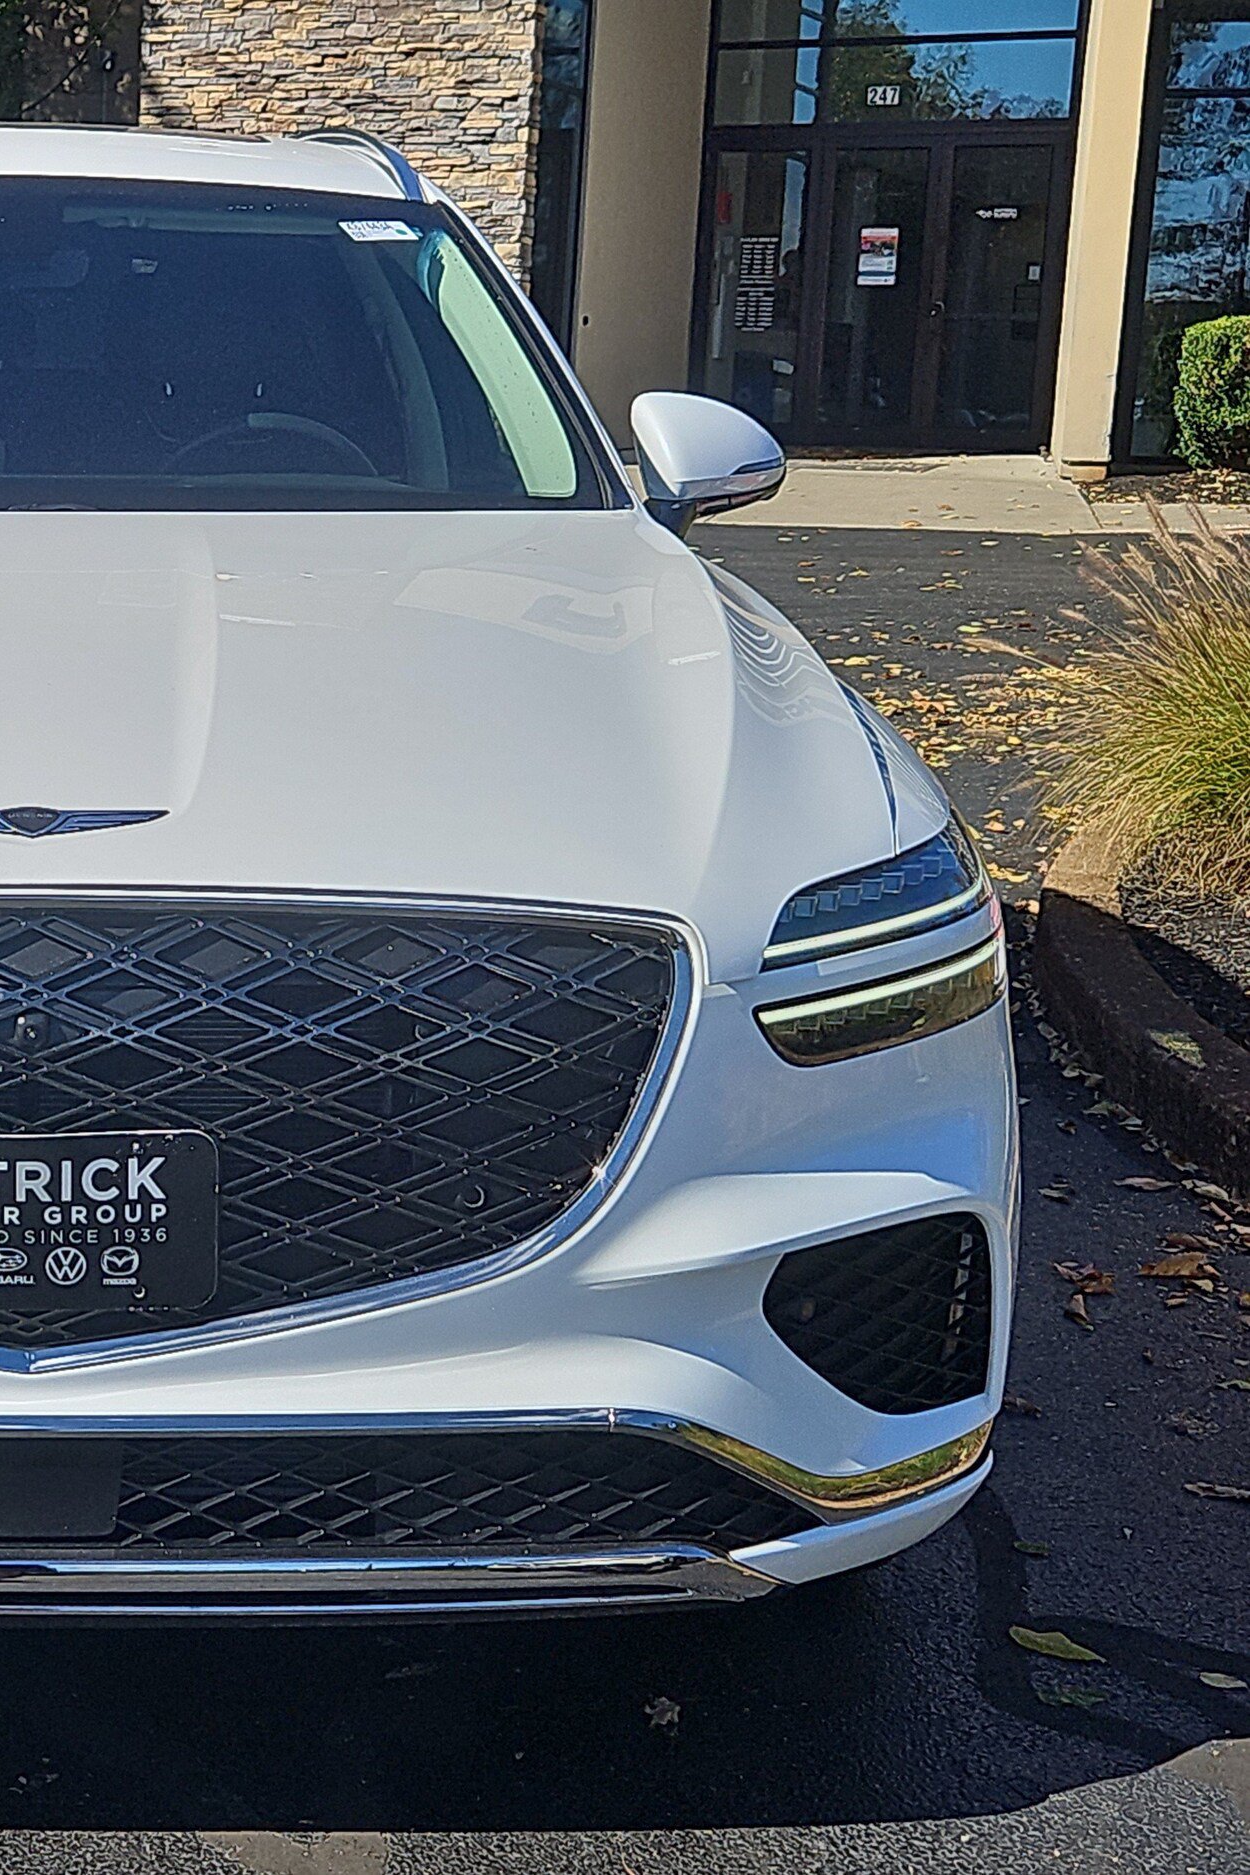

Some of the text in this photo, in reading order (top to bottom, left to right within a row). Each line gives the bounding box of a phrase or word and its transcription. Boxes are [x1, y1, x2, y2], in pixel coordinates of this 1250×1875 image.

[869, 87, 898, 104] 247
[43, 1203, 167, 1225] GROUP
[24, 1228, 99, 1245] SINCE
[113, 1227, 167, 1243] 1936
